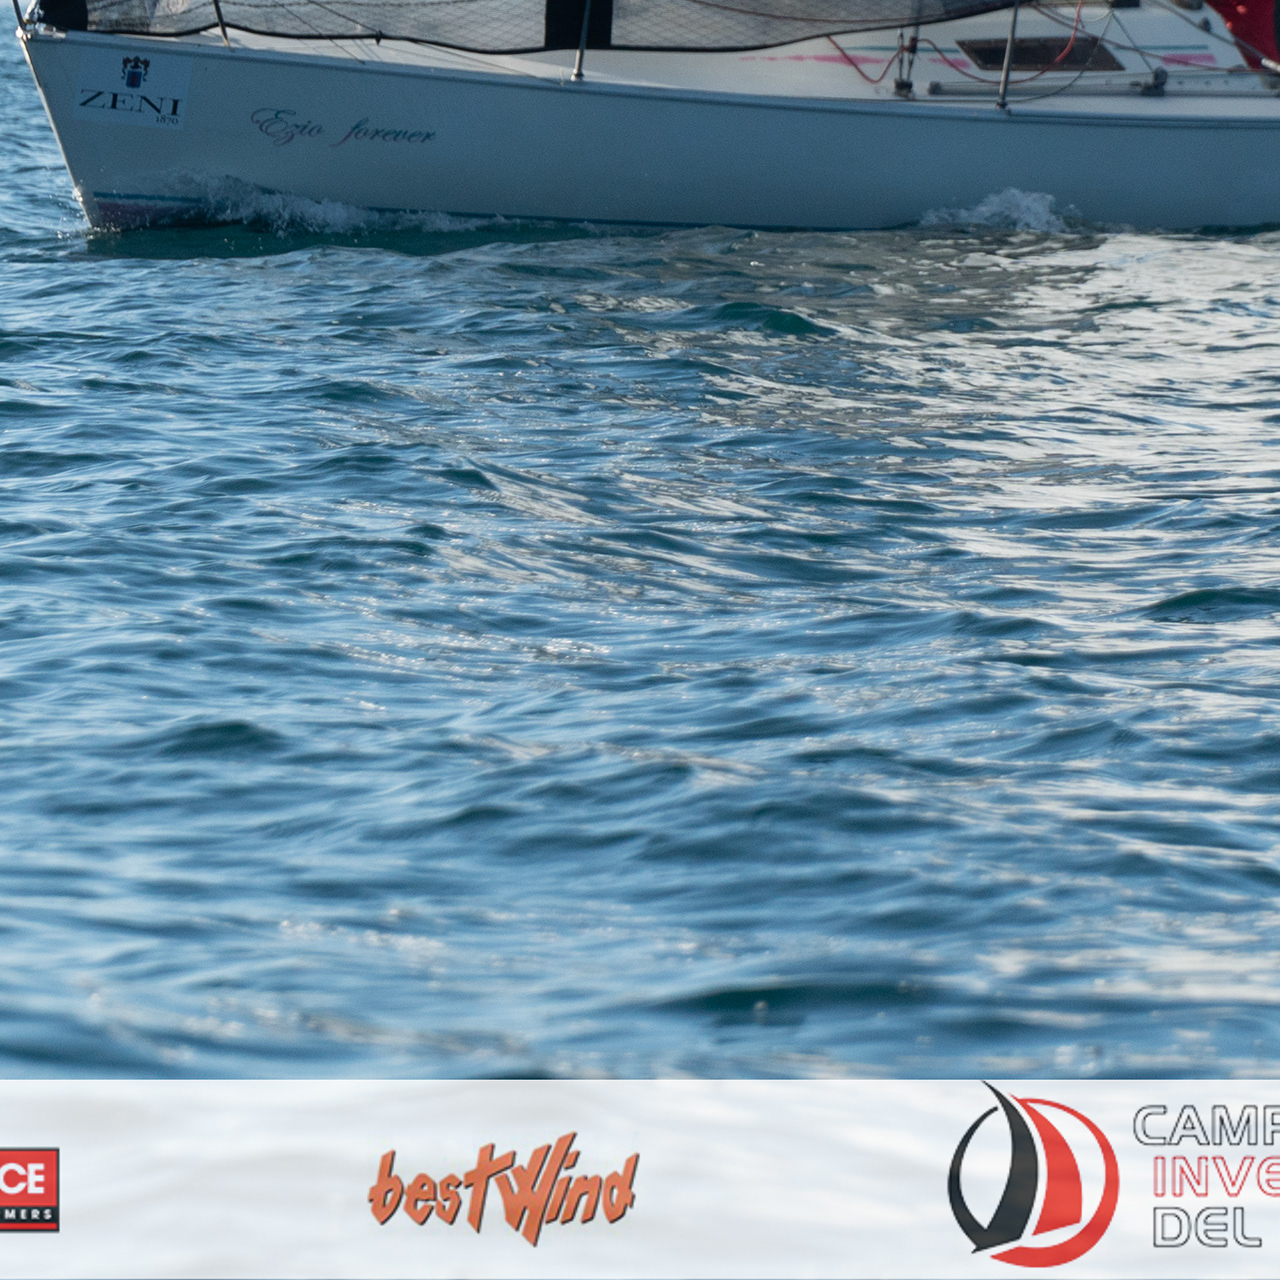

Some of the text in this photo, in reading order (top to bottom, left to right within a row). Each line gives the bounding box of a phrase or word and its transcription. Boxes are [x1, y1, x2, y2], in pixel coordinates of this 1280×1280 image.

[78, 88, 184, 117] ZENI
[250, 107, 437, 148] Ezio forever
